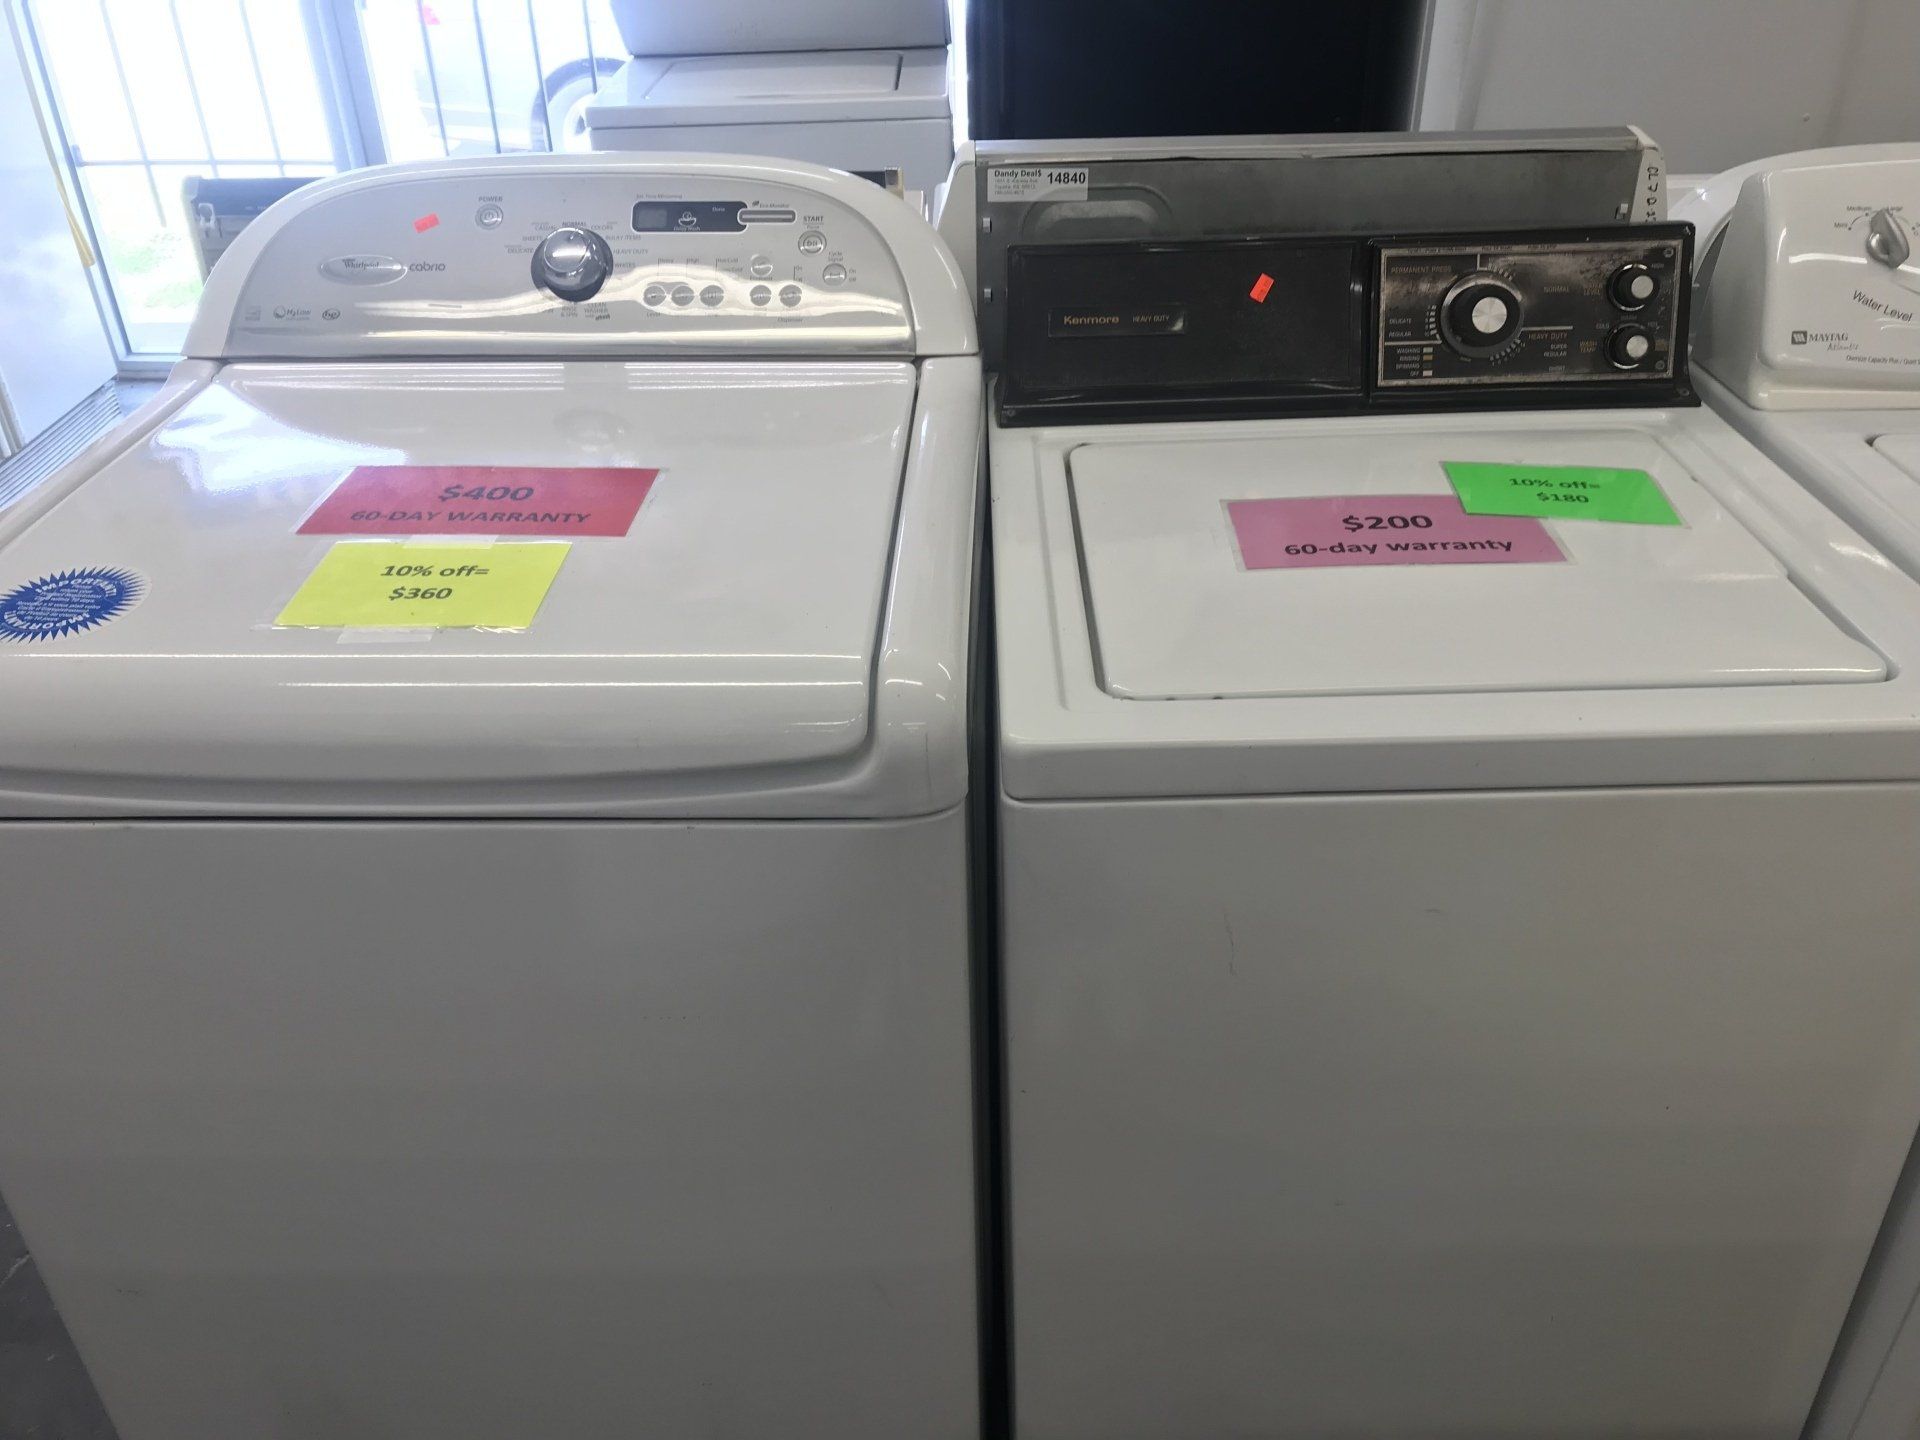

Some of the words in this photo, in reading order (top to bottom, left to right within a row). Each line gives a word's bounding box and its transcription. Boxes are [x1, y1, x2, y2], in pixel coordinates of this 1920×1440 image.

[994, 169, 1019, 179] Dandy
[1047, 172, 1086, 184] 14840
[409, 261, 446, 272] cabrio
[1853, 290, 1883, 311] Water
[1884, 305, 1914, 324] Level
[1063, 315, 1120, 325] Kenmore
[1809, 332, 1848, 342] MAYTAG
[1509, 478, 1553, 488] 10%
[438, 484, 534, 502] $400
[1537, 491, 1590, 504] $180
[350, 510, 441, 522] 60-DAY
[447, 511, 591, 524] WARRANTY
[1342, 514, 1433, 533] $200
[1285, 542, 1377, 557] 60-day
[1385, 538, 1513, 553] warranty
[380, 565, 432, 578] 10%
[439, 565, 490, 578] off=
[388, 586, 452, 602] $360
